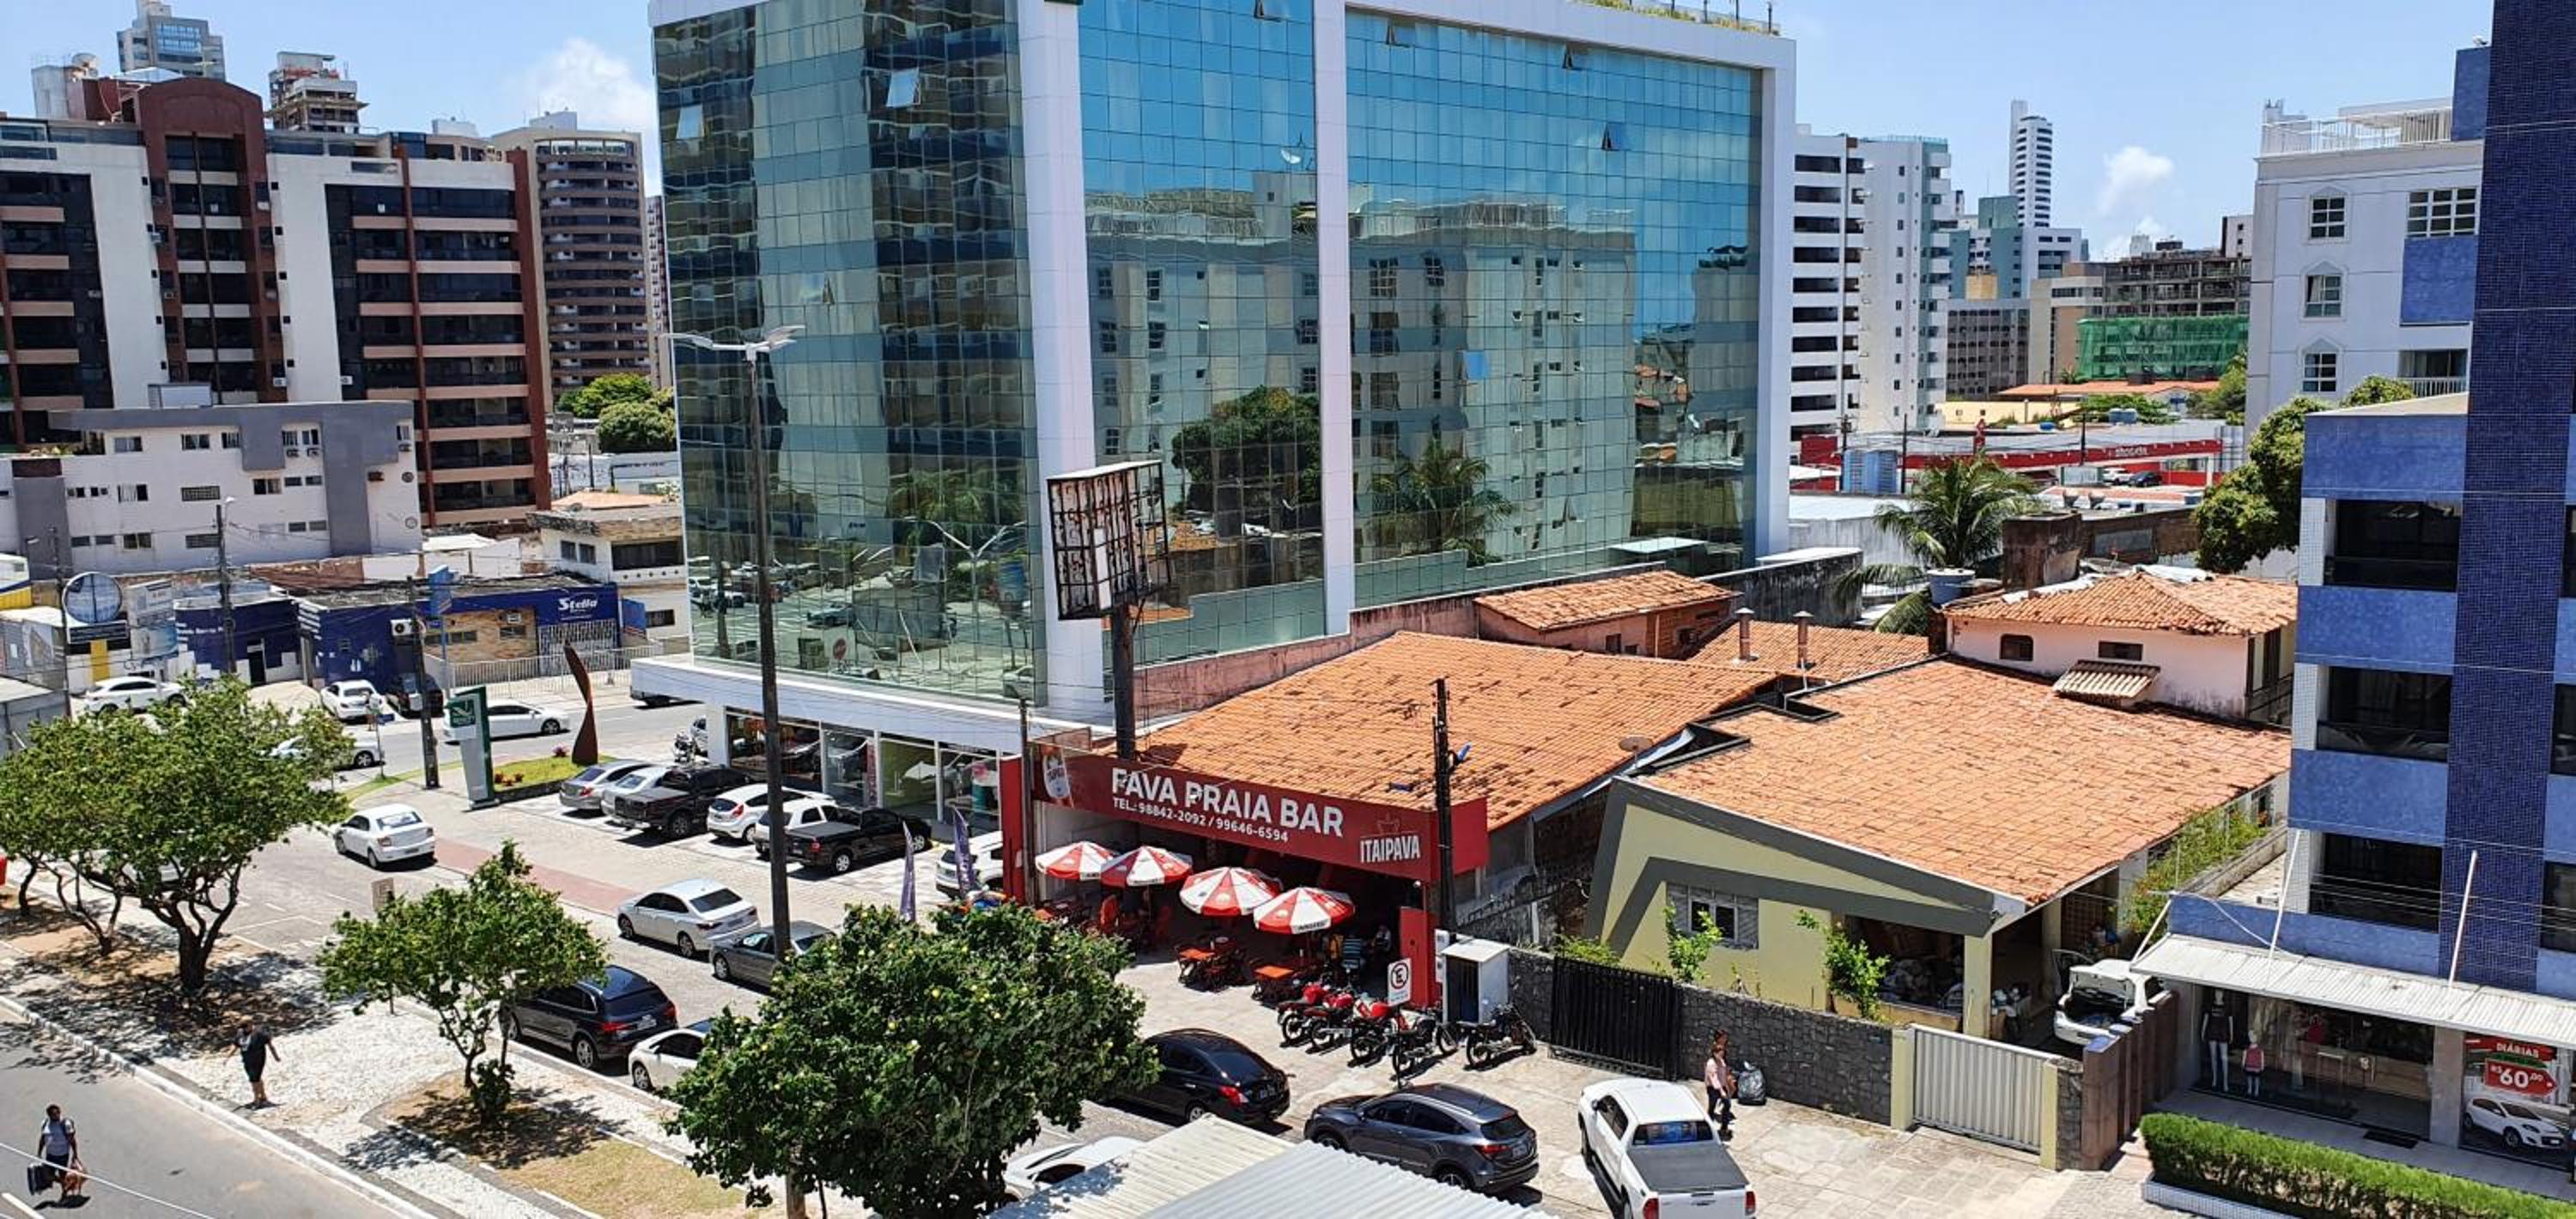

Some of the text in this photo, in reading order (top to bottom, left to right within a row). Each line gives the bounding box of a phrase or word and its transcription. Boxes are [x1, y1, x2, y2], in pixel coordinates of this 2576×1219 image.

[558, 597, 598, 611] Stella
[1113, 767, 1344, 838] FAVA PRAIA BAR
[1216, 817, 1288, 842] 99646-6594
[1359, 835, 1421, 864] ITAIPAVA
[2496, 1042, 2539, 1058] DIÁRIAS
